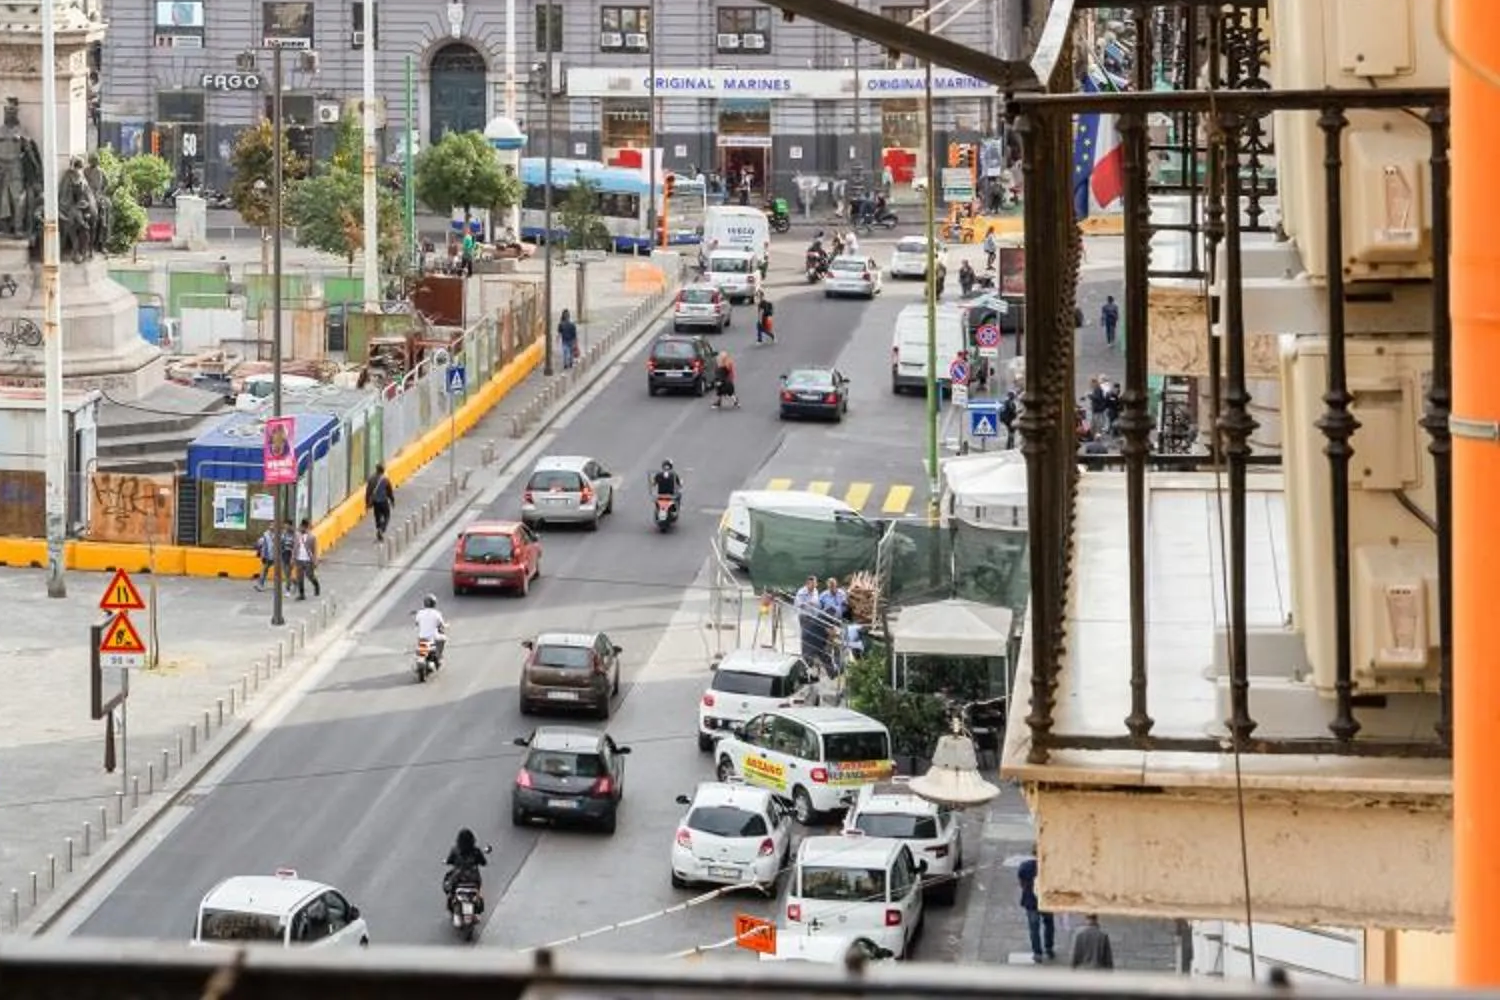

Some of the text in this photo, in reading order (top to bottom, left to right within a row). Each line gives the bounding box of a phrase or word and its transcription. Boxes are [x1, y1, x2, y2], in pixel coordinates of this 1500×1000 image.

[203, 75, 259, 91] FAGO
[643, 77, 791, 90] ORIGINAL MARINES
